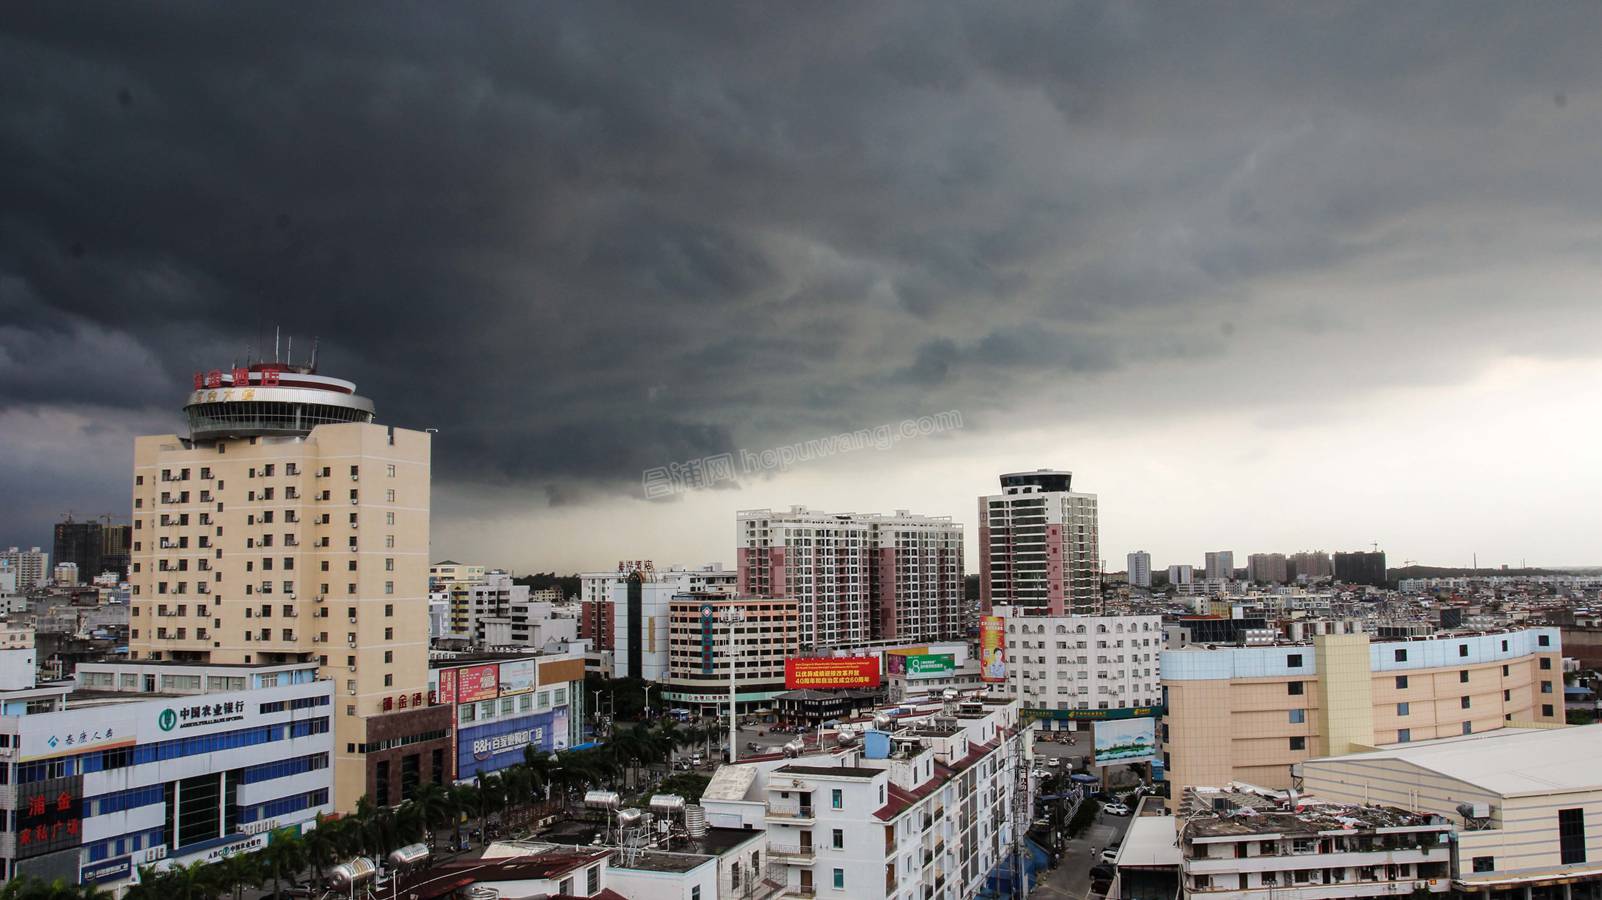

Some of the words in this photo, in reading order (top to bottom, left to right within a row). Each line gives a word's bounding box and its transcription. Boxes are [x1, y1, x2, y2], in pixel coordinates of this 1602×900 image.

[180, 700, 244, 720] 中国农业银行
[65, 727, 114, 745] 泰康人寿
[28, 791, 72, 816] 浦金
[208, 849, 224, 860] ABC
[230, 838, 261, 852] 中国农业银行
